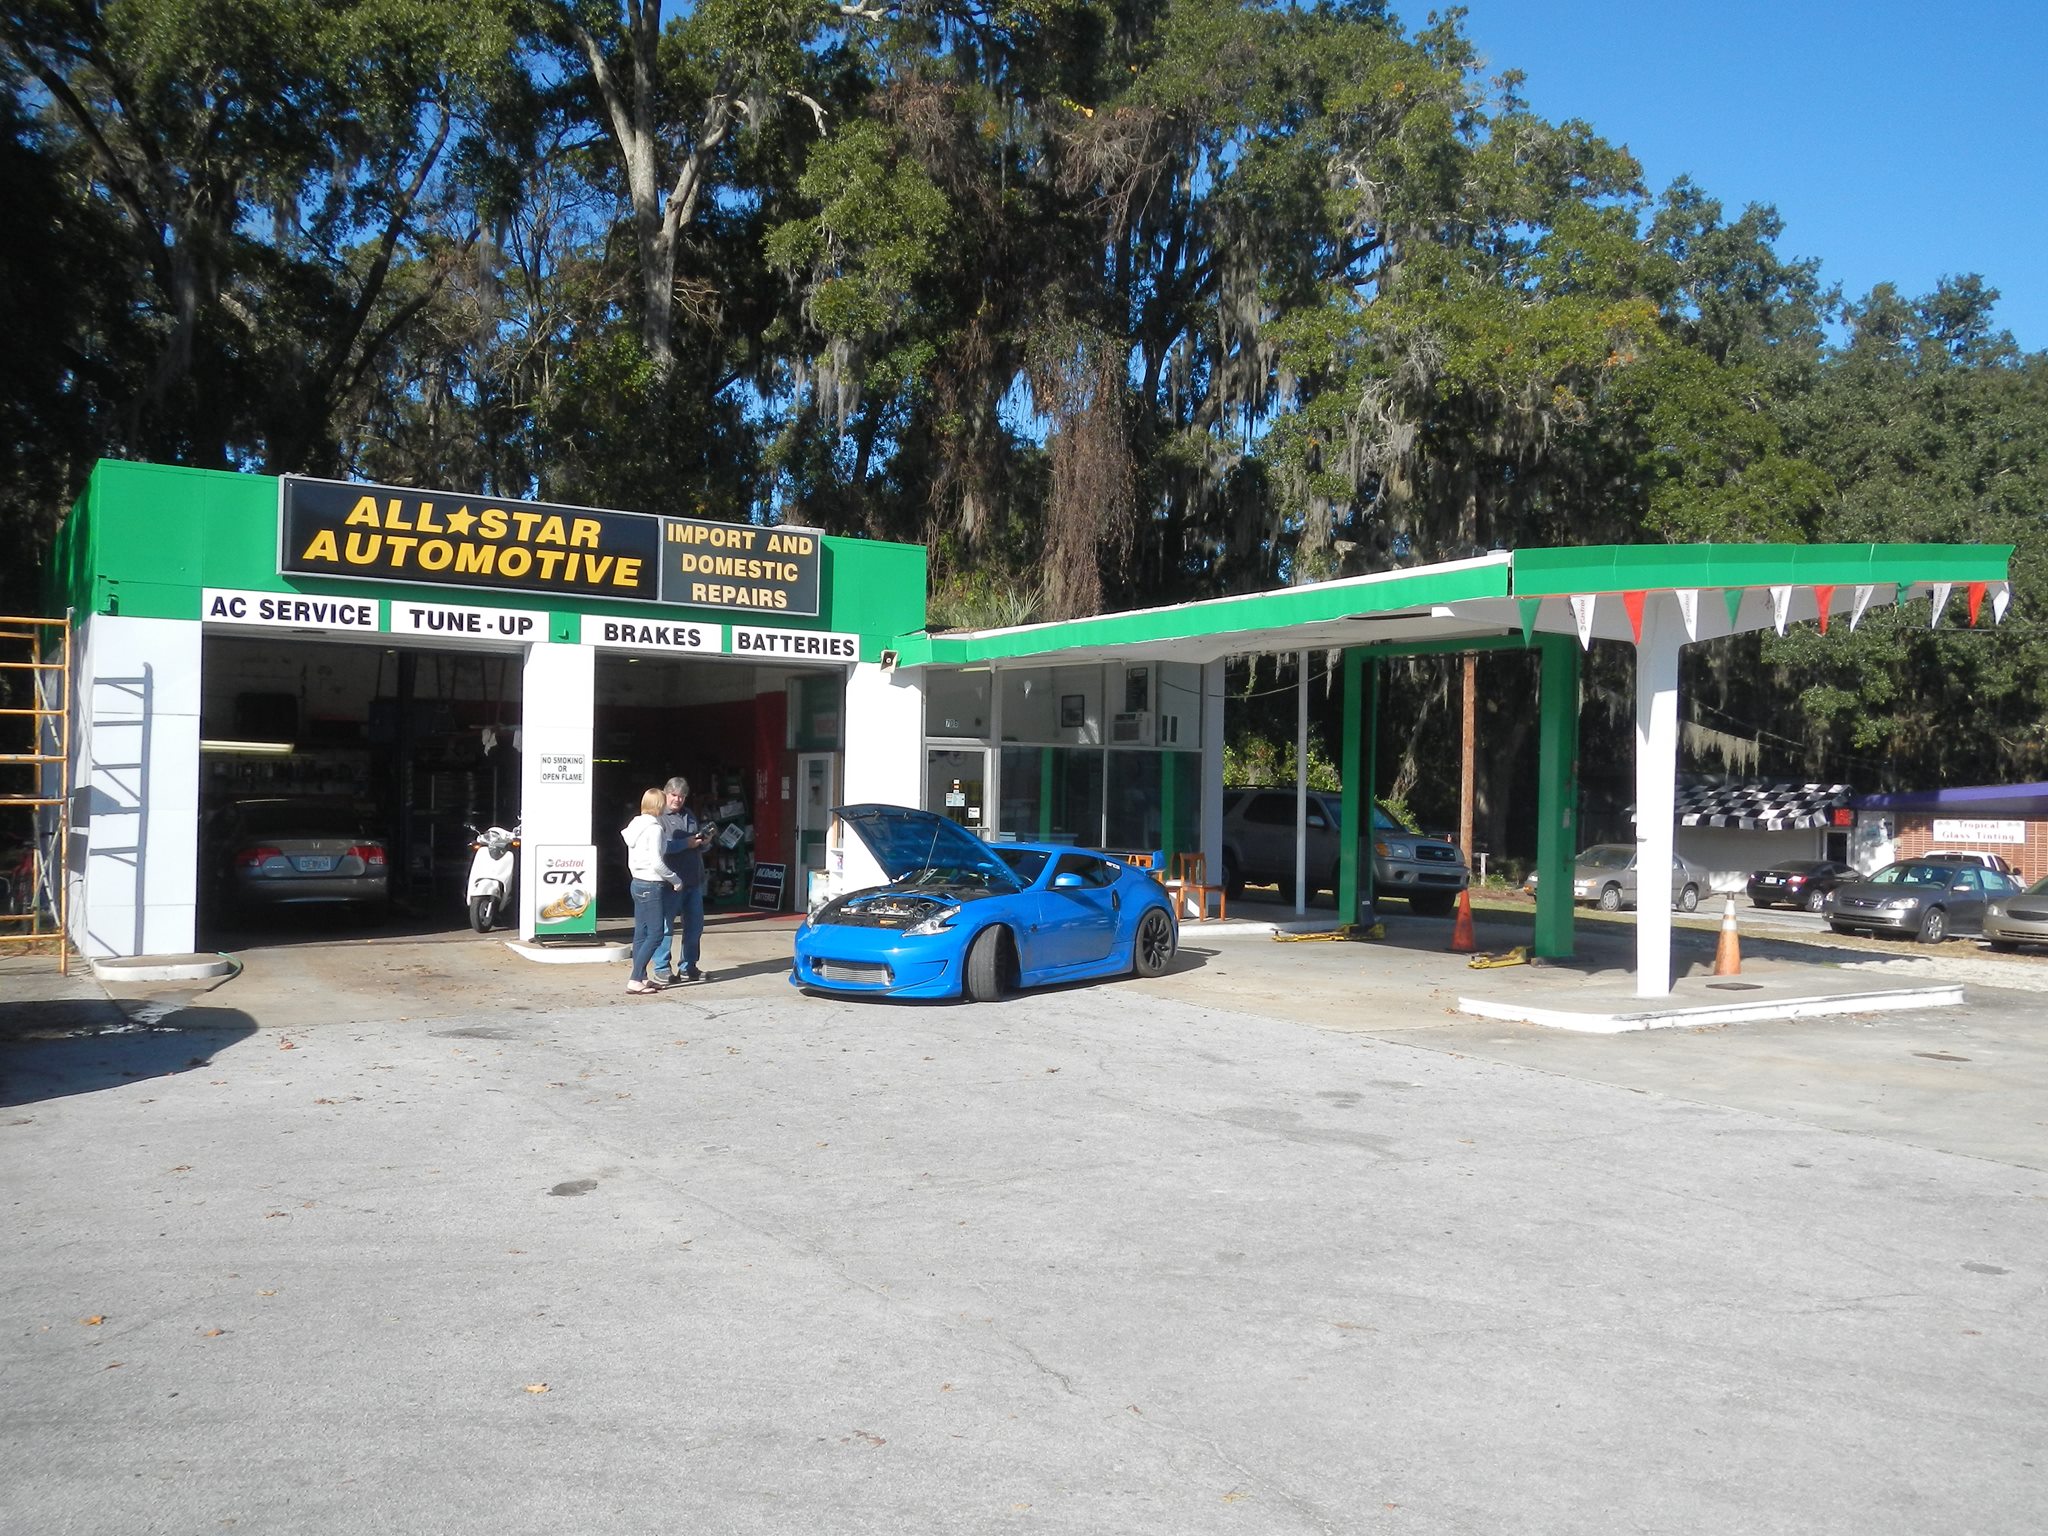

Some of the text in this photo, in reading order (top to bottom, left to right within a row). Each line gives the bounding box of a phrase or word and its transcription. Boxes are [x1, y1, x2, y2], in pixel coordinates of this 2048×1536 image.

[345, 496, 602, 549] ALL STAR
[667, 523, 814, 556] IMPORT AND
[302, 529, 643, 588] AUTOMOTIVE
[682, 554, 799, 583] DOMESTIC
[692, 583, 788, 609] REPAIRS
[211, 597, 373, 626] AC SERVICE
[604, 622, 702, 648] BRAKES
[738, 632, 855, 658] BATTERIES
[553, 757, 584, 765] SMOKING
[558, 765, 568, 773] OR
[542, 773, 583, 781] OPEN FLAME
[1942, 831, 2015, 841] Glass Tinting
[1958, 820, 1999, 829] Tropical
[555, 859, 585, 868] Castrol
[543, 871, 586, 885] GTX
